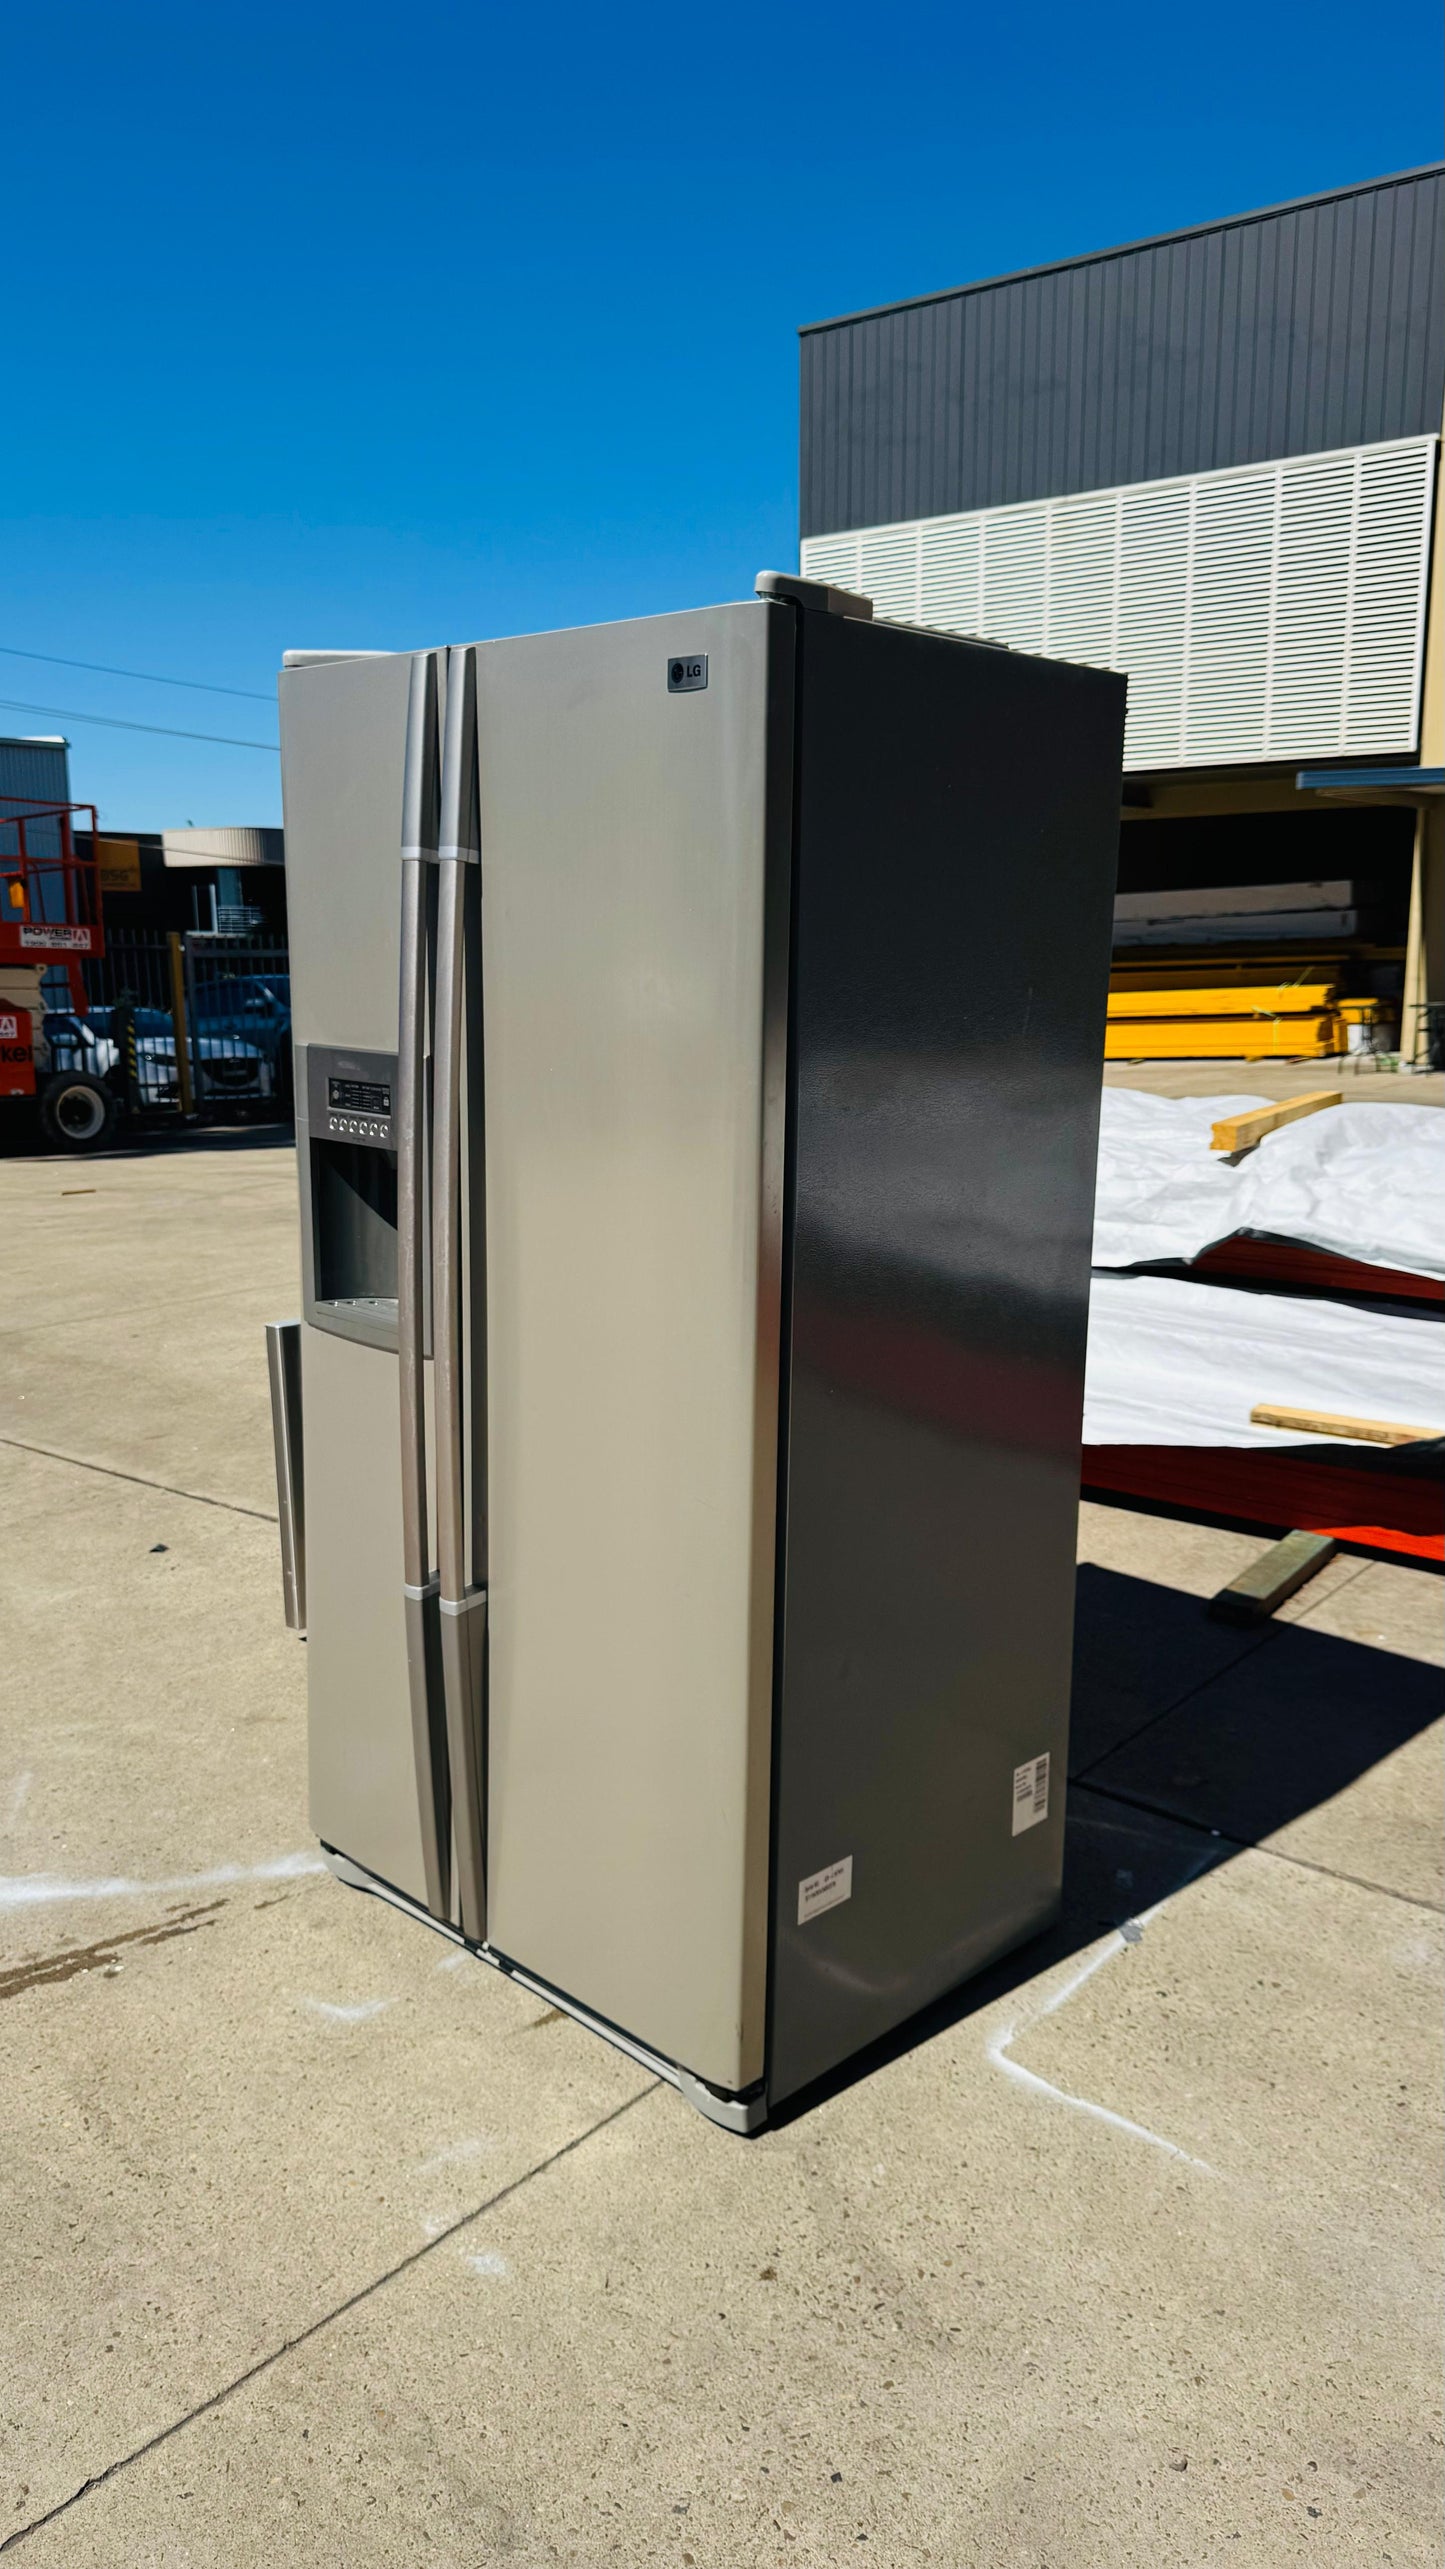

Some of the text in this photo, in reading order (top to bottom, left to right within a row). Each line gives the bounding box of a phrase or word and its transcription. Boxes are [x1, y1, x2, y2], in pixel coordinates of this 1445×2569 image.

[687, 665, 701, 677] LG
[23, 927, 72, 936] POWER
[0, 1043, 33, 1063] kel
